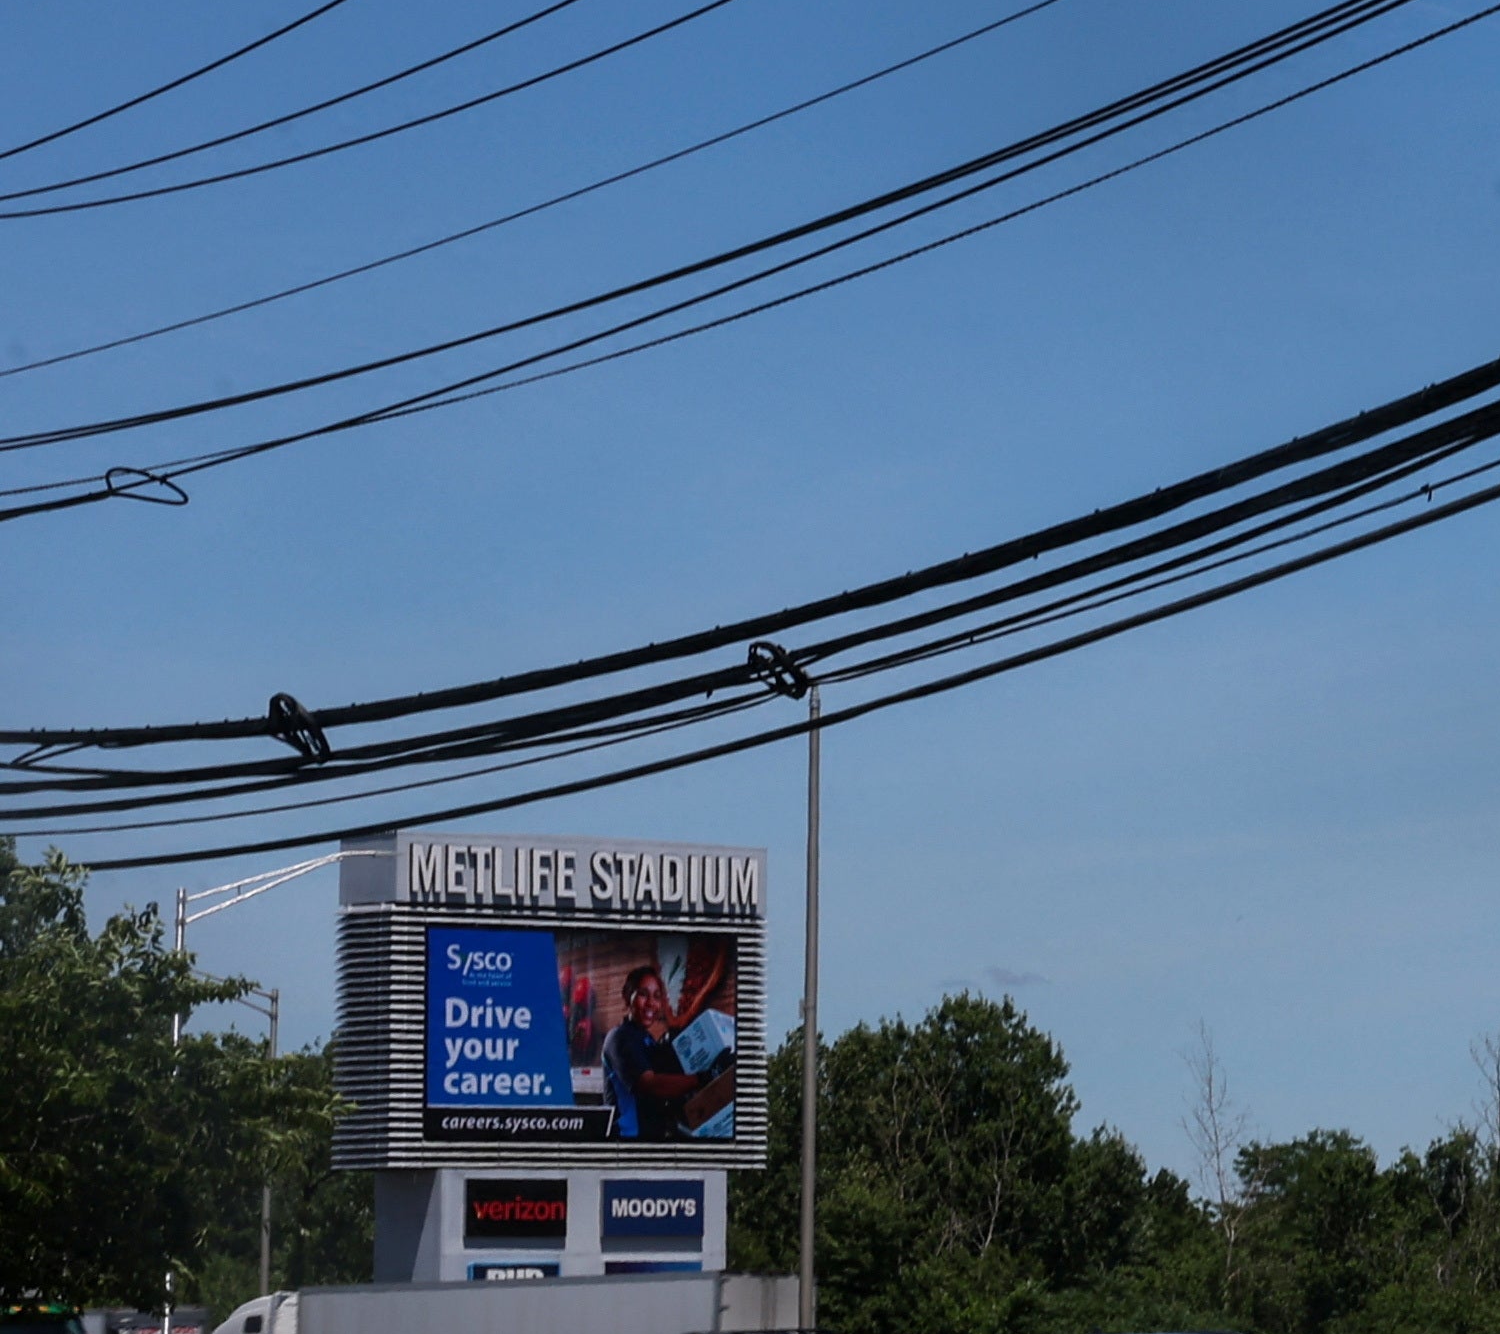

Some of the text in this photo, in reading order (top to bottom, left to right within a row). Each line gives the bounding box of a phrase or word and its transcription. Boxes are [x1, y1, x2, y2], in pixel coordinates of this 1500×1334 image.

[410, 843, 759, 906] METLIFE STADIUM
[445, 997, 532, 1029] Drive
[444, 1037, 519, 1068] your
[443, 1071, 552, 1095] career.
[441, 1116, 584, 1134] careers.sysco.com
[474, 1196, 566, 1221] verizon
[612, 1198, 696, 1217] MOODY'S
